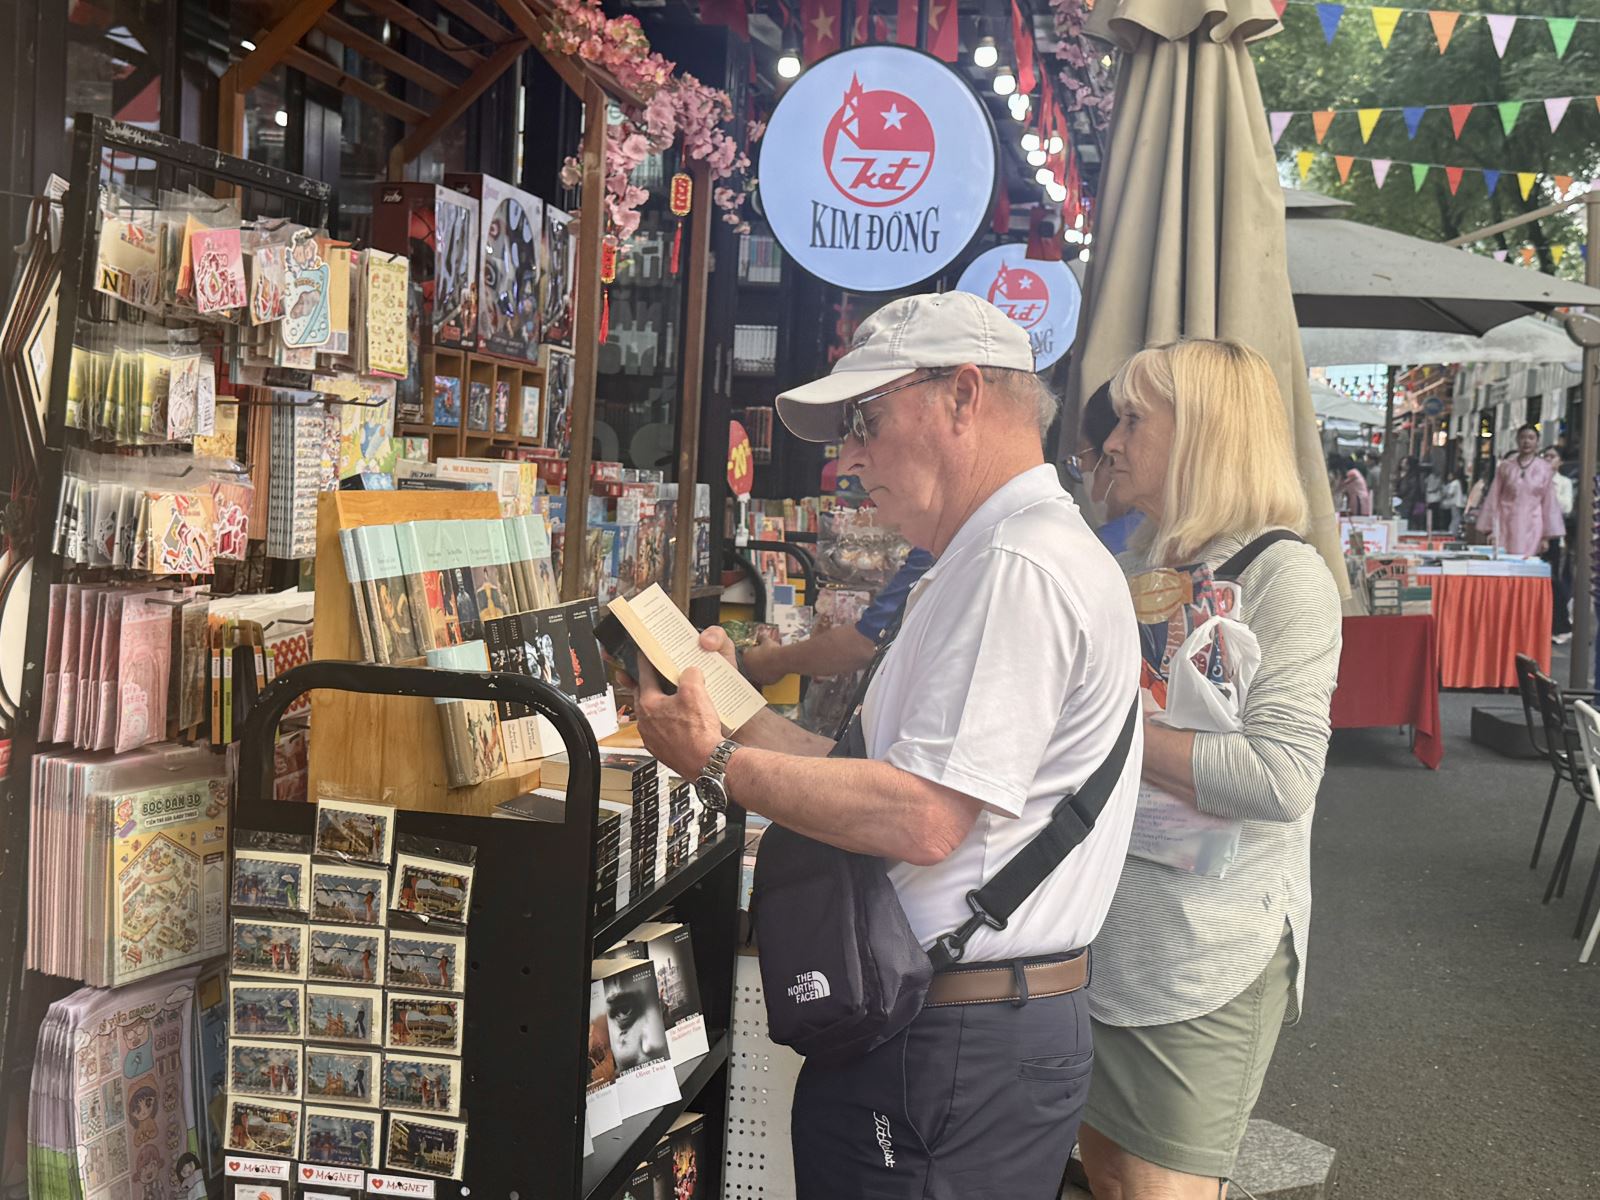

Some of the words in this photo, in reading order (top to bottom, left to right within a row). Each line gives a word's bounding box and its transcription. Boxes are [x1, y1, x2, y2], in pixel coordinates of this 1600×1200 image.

[809, 199, 862, 250] KIM
[452, 464, 490, 474] WARNING
[186, 793, 201, 808] 3D
[796, 971, 813, 983] THE
[788, 981, 815, 997] NORTH
[796, 990, 816, 1004] FACE
[619, 1064, 642, 1078] CHARLES
[635, 1069, 651, 1079] Oliver
[652, 1064, 666, 1073] Twist
[872, 1111, 895, 1168] Titleist
[243, 1163, 283, 1175] MAGNET
[316, 1171, 361, 1184] MAGNET
[386, 1180, 428, 1194] MAGNET
